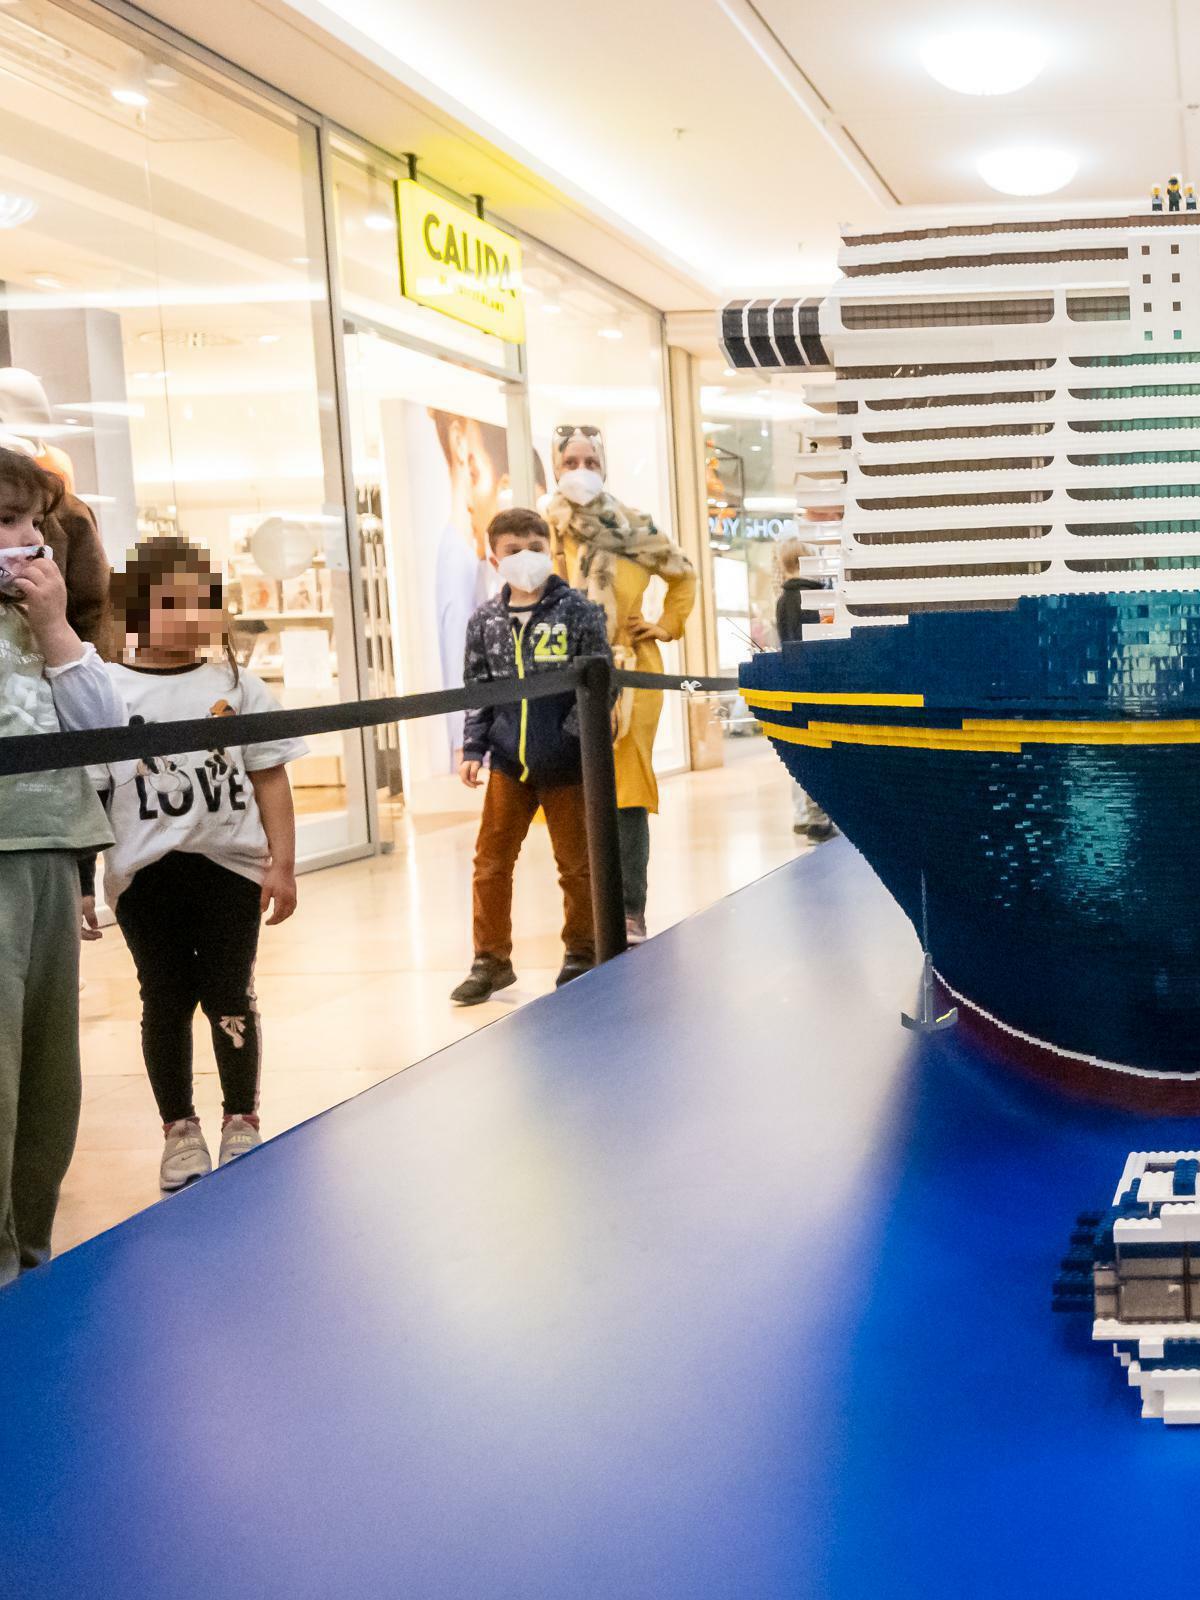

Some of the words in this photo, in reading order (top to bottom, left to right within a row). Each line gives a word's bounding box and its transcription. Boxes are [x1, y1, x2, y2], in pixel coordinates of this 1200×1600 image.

[423, 213, 516, 298] CALIDA
[534, 622, 568, 655] 23
[134, 767, 246, 820] LOVE
